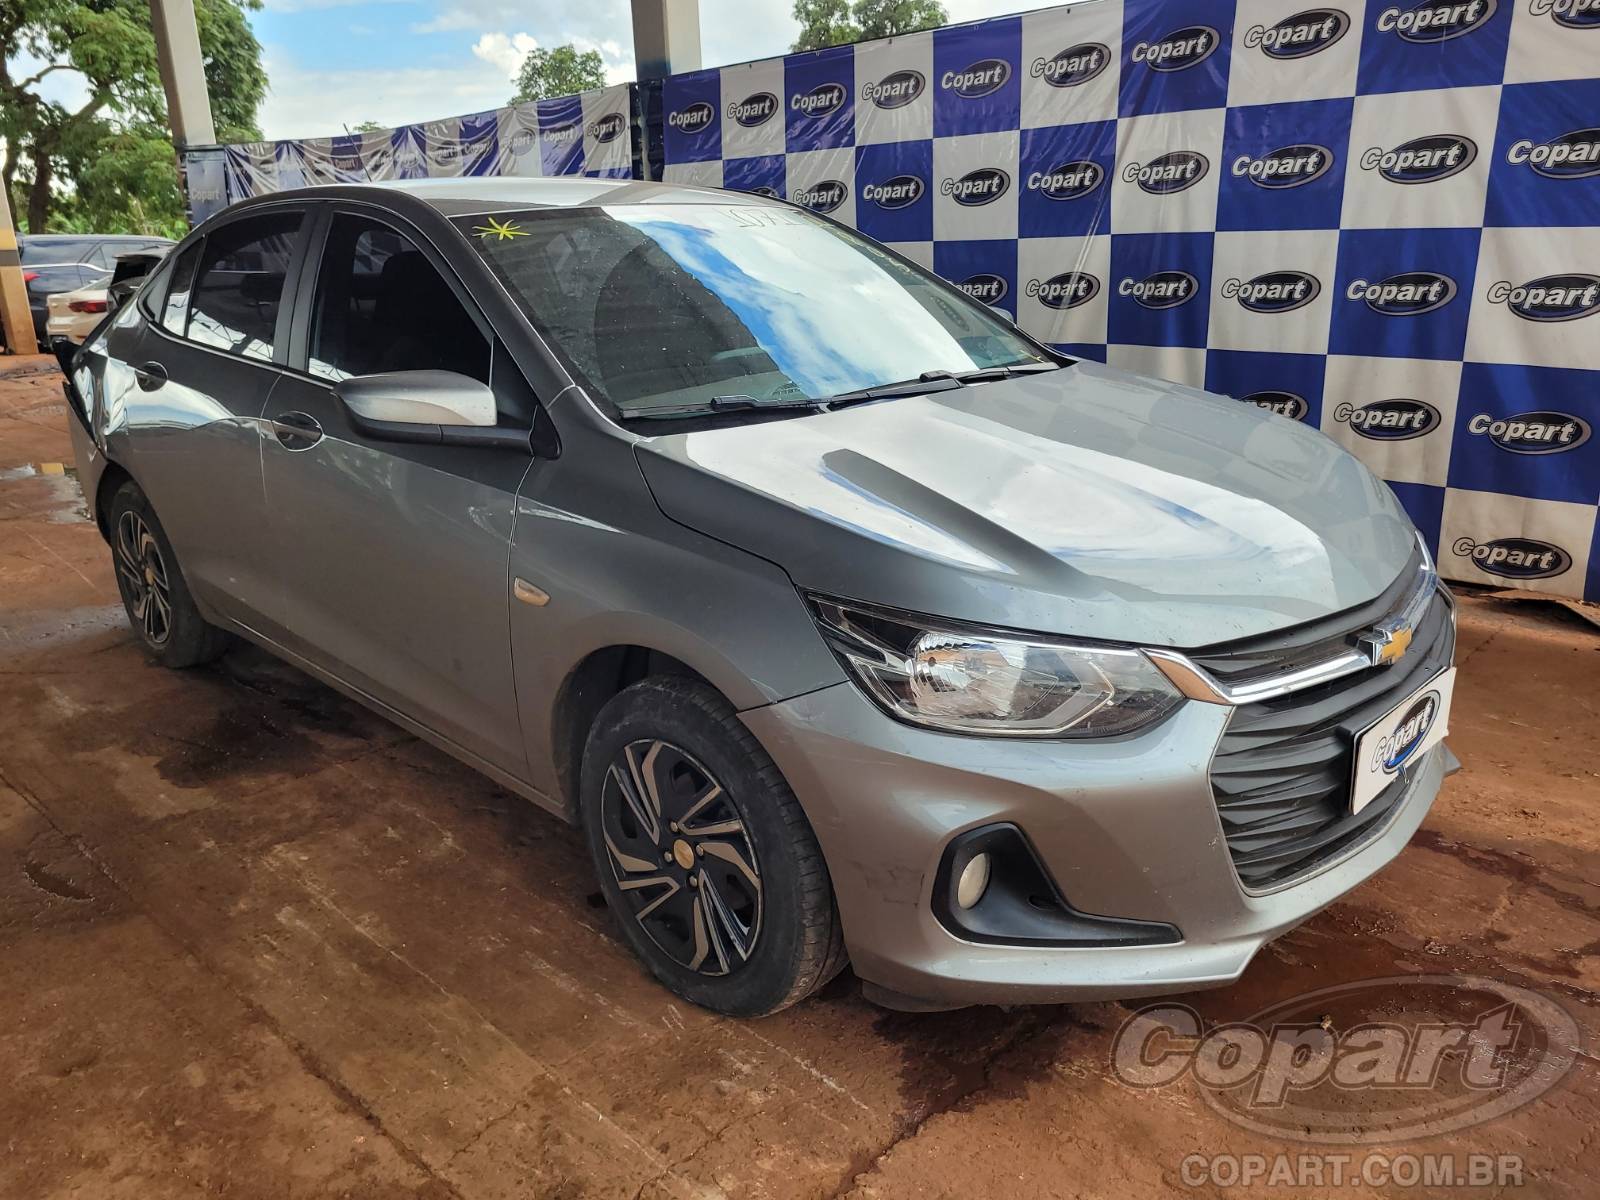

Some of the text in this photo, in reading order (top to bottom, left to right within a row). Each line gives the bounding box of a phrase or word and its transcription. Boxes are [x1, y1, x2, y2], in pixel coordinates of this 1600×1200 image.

[1376, 0, 1480, 36] Copart
[1244, 16, 1335, 52] Copart
[1030, 46, 1100, 80] Copart
[1131, 32, 1207, 66] Copart
[862, 78, 916, 103] Copart
[941, 63, 1001, 91] Copart
[727, 99, 772, 122] Copart
[791, 88, 840, 114] Copart
[668, 109, 709, 129] Copart
[543, 127, 574, 143] Copart
[1122, 156, 1197, 187] Copart
[1232, 149, 1322, 182] Copart
[1360, 141, 1462, 176] Copart
[863, 180, 915, 205] Copart
[941, 173, 1001, 200] Copart
[1027, 165, 1094, 194] Copart
[793, 187, 841, 207] Copart
[1025, 279, 1089, 301] Copart
[1118, 279, 1188, 301] Copart
[1221, 278, 1307, 303] Copart
[1346, 279, 1443, 306] Copart
[1487, 280, 1599, 310] Copart
[1334, 402, 1428, 432] Copart
[1468, 414, 1577, 447] Copart
[1452, 536, 1556, 570] Copart
[1371, 694, 1435, 773] Copart
